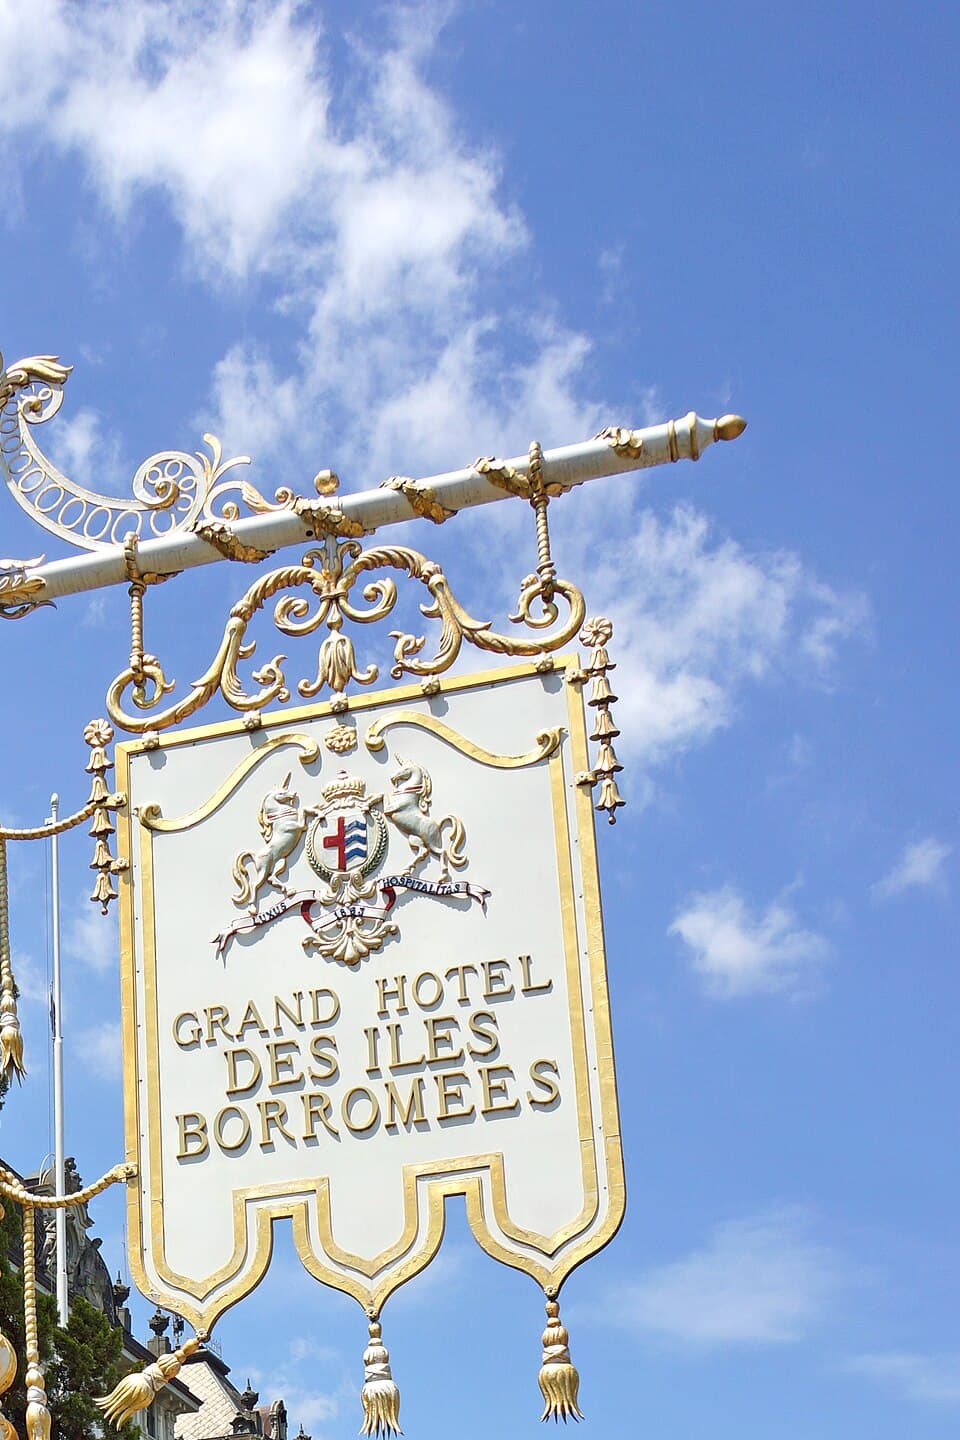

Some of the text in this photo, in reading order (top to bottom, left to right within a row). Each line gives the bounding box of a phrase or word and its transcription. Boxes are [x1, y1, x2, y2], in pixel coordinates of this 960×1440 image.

[252, 902, 287, 925] LUXUS
[382, 876, 460, 894] HOSPITALITAS
[172, 954, 553, 1047] GRAND HOTEL
[223, 1009, 499, 1095] DES ILES
[175, 1058, 560, 1159] BORROMEES
